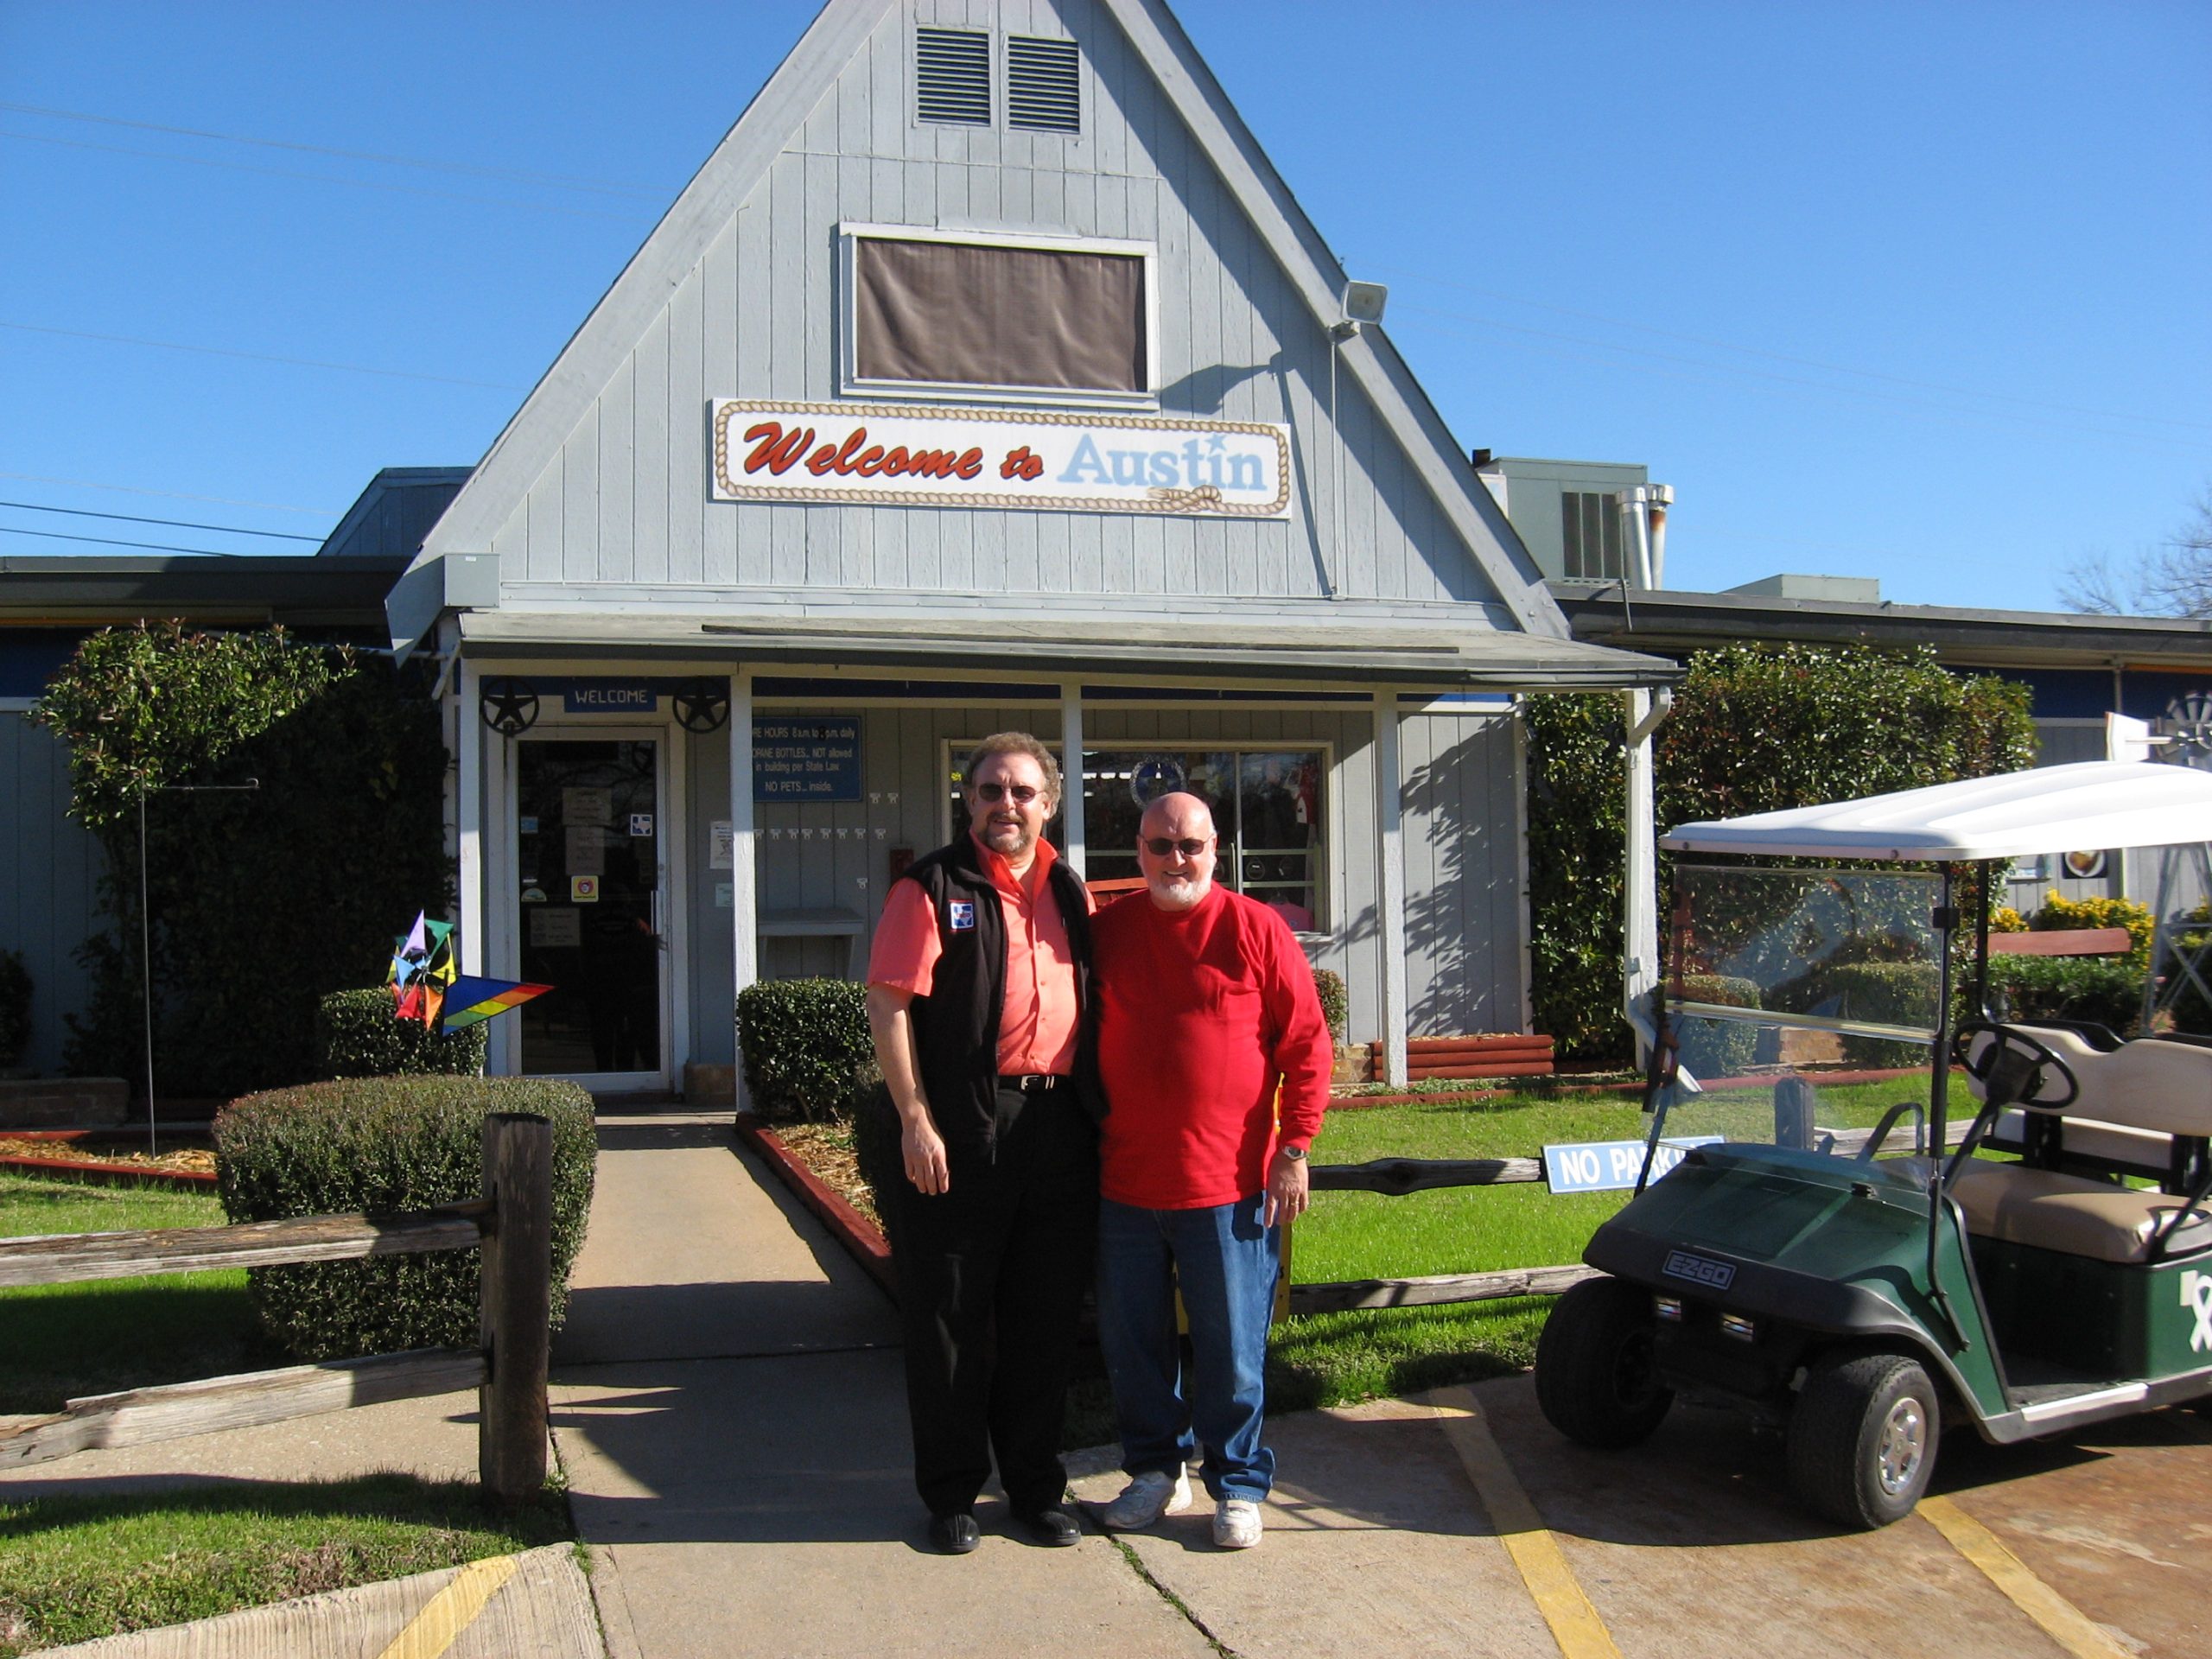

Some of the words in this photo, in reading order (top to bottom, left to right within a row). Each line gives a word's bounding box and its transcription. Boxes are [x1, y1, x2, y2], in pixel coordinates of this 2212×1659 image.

[743, 422, 983, 480] Welcome
[1000, 445, 1044, 480] to
[1056, 433, 1268, 491] Austin
[575, 690, 648, 703] WELCOME
[764, 727, 789, 738] HOURS
[839, 727, 855, 740] daily
[753, 747, 773, 759] OPANE
[812, 747, 826, 759] NOT
[828, 747, 853, 759] allowed
[765, 761, 790, 773] building
[791, 763, 803, 773] per
[805, 760, 823, 772] State
[765, 781, 778, 791] NO
[1559, 1148, 1600, 1185] NO
